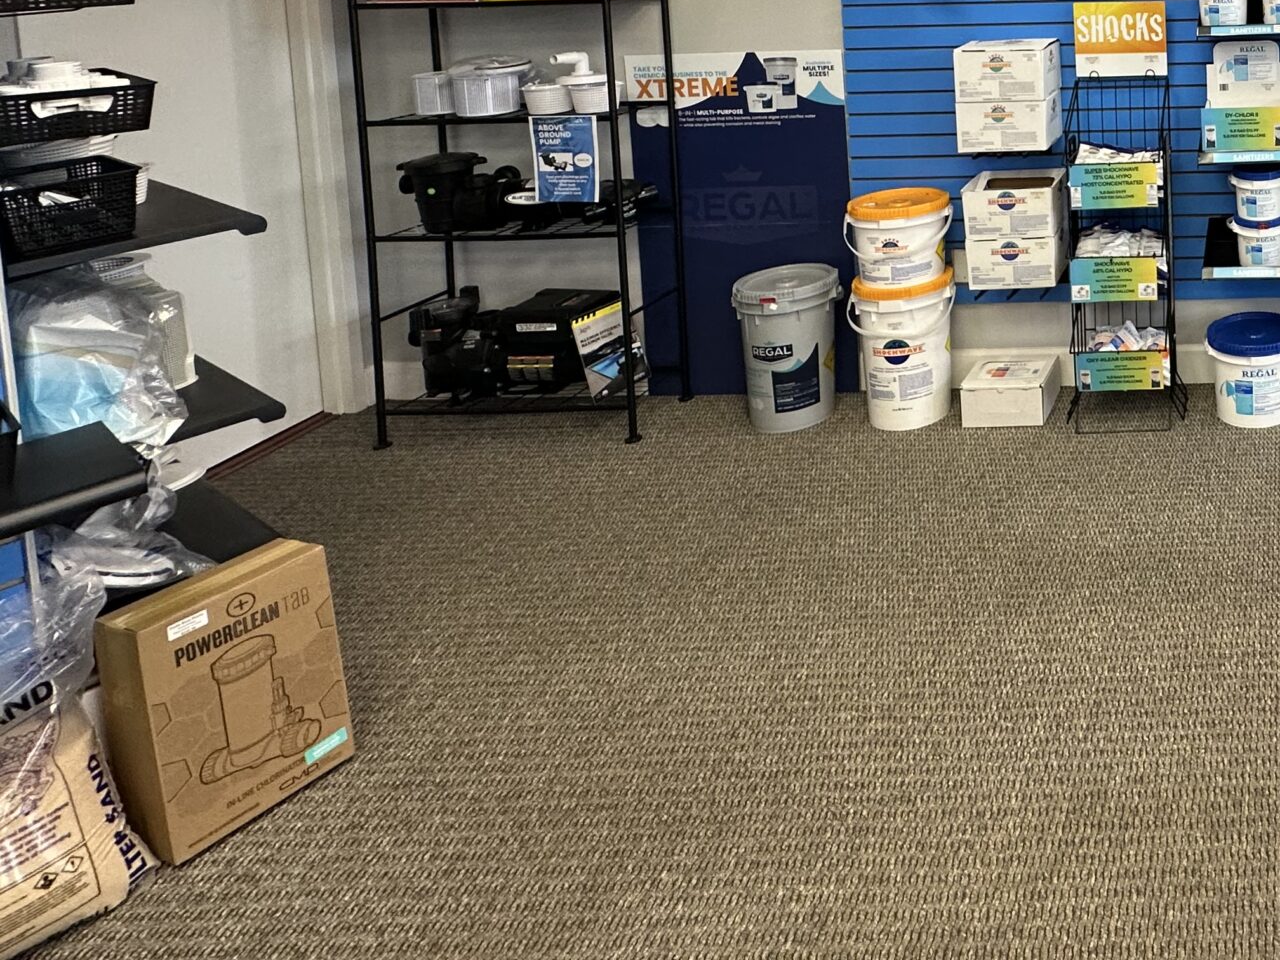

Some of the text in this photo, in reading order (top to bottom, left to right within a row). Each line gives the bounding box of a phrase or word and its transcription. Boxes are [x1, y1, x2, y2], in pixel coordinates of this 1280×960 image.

[1076, 12, 1164, 44] SHOCKS
[635, 76, 740, 99] XTREME
[538, 124, 564, 132] ABOVE
[752, 346, 792, 357] REGAL
[873, 344, 926, 358] SHOCKWAVE
[1242, 368, 1278, 378] REGAL
[0, 680, 54, 726] ND
[278, 761, 320, 792] CMP
[86, 753, 149, 890] ILTER SAND
